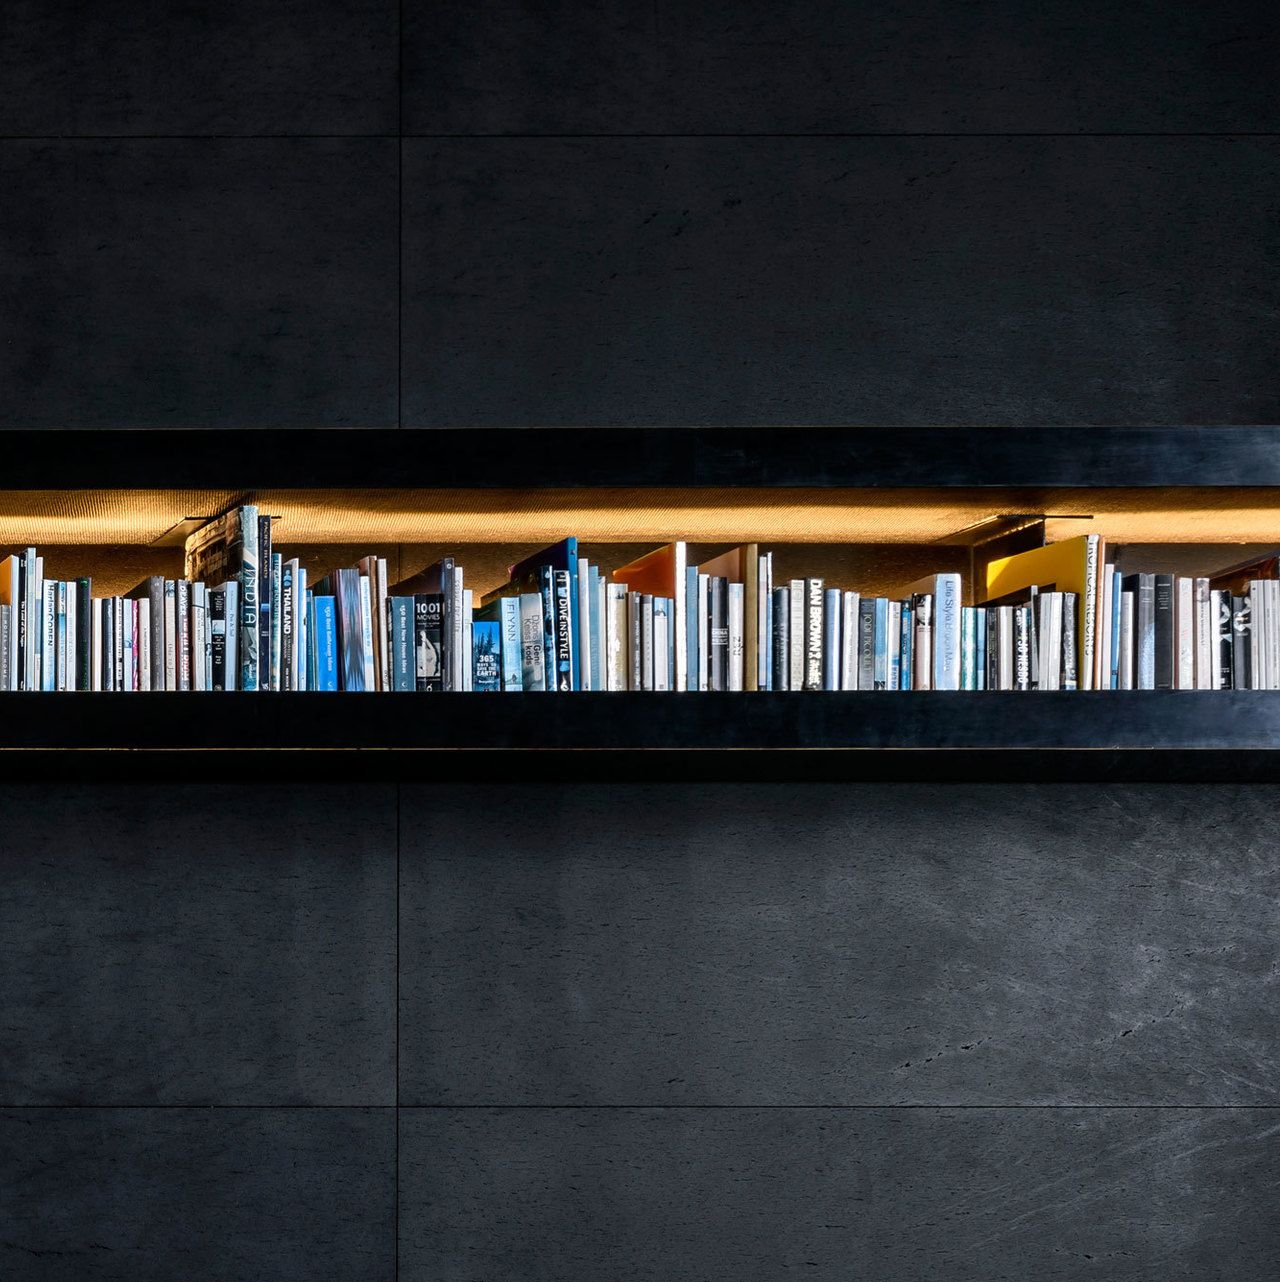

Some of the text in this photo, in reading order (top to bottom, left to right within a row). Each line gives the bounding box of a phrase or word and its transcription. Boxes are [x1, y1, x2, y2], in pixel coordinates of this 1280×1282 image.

[245, 569, 256, 624] INDIA
[810, 580, 822, 605] DAN
[416, 603, 440, 613] 1001
[944, 600, 953, 621] Style
[810, 607, 822, 652] BROWN
